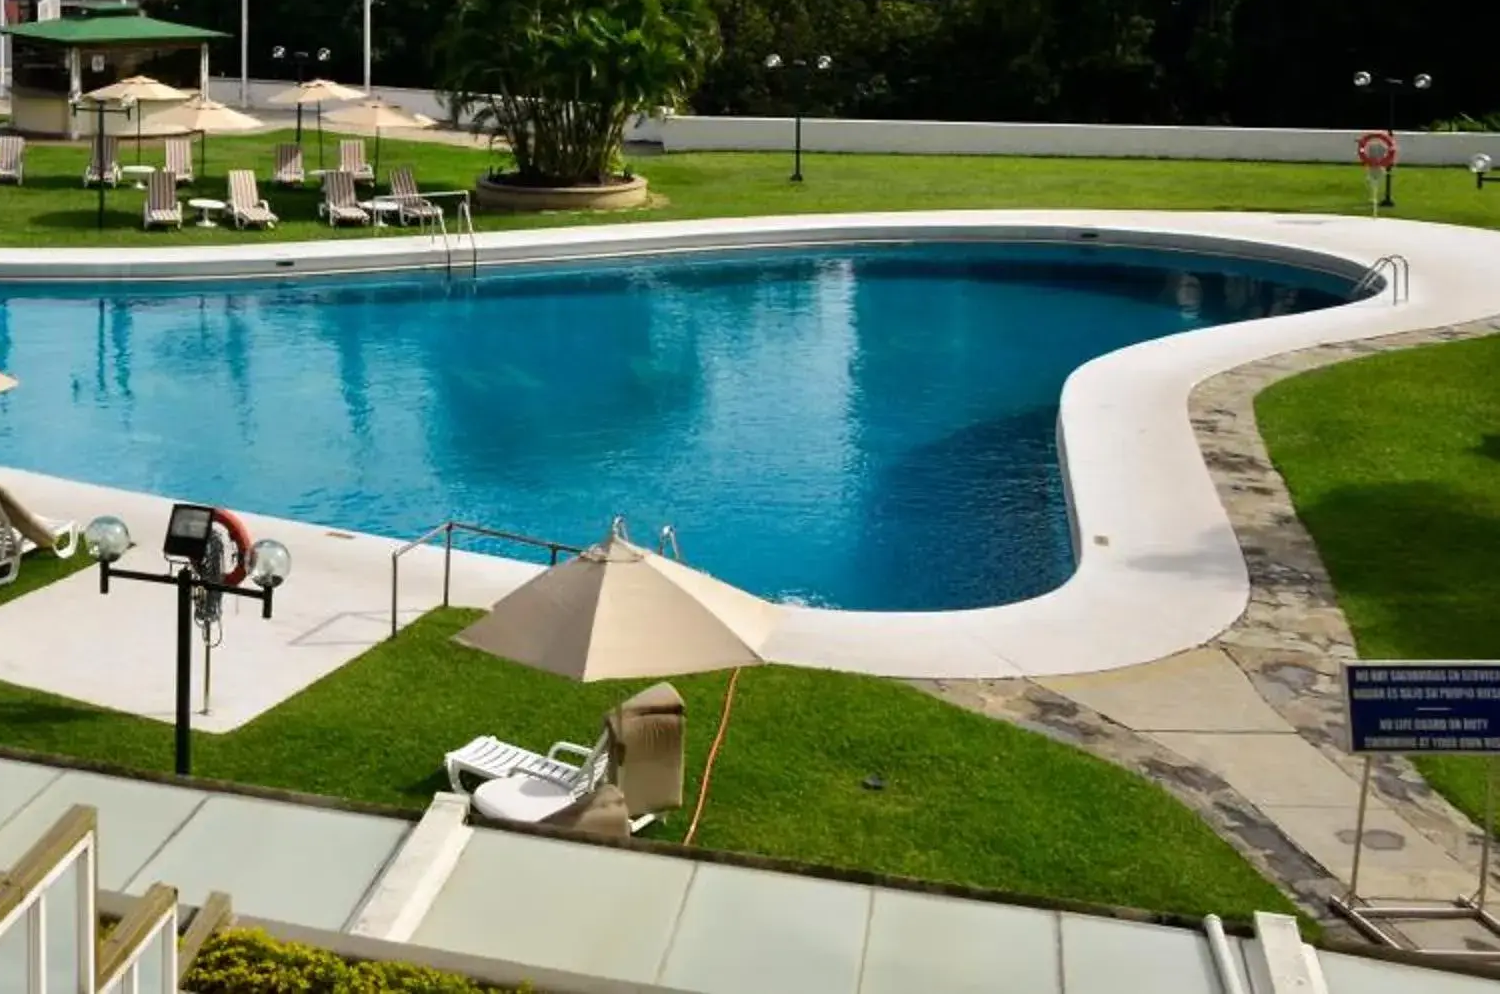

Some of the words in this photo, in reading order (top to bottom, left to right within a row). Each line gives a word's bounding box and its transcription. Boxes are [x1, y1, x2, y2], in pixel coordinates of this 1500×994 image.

[1355, 669, 1368, 682] NO
[1370, 669, 1388, 682] HAY
[1448, 669, 1460, 682] EN
[1379, 718, 1392, 730] NO
[1395, 718, 1412, 730] LIFE
[1414, 718, 1446, 730] GUARD
[1448, 718, 1462, 730] ON
[1463, 718, 1489, 730] DUTY
